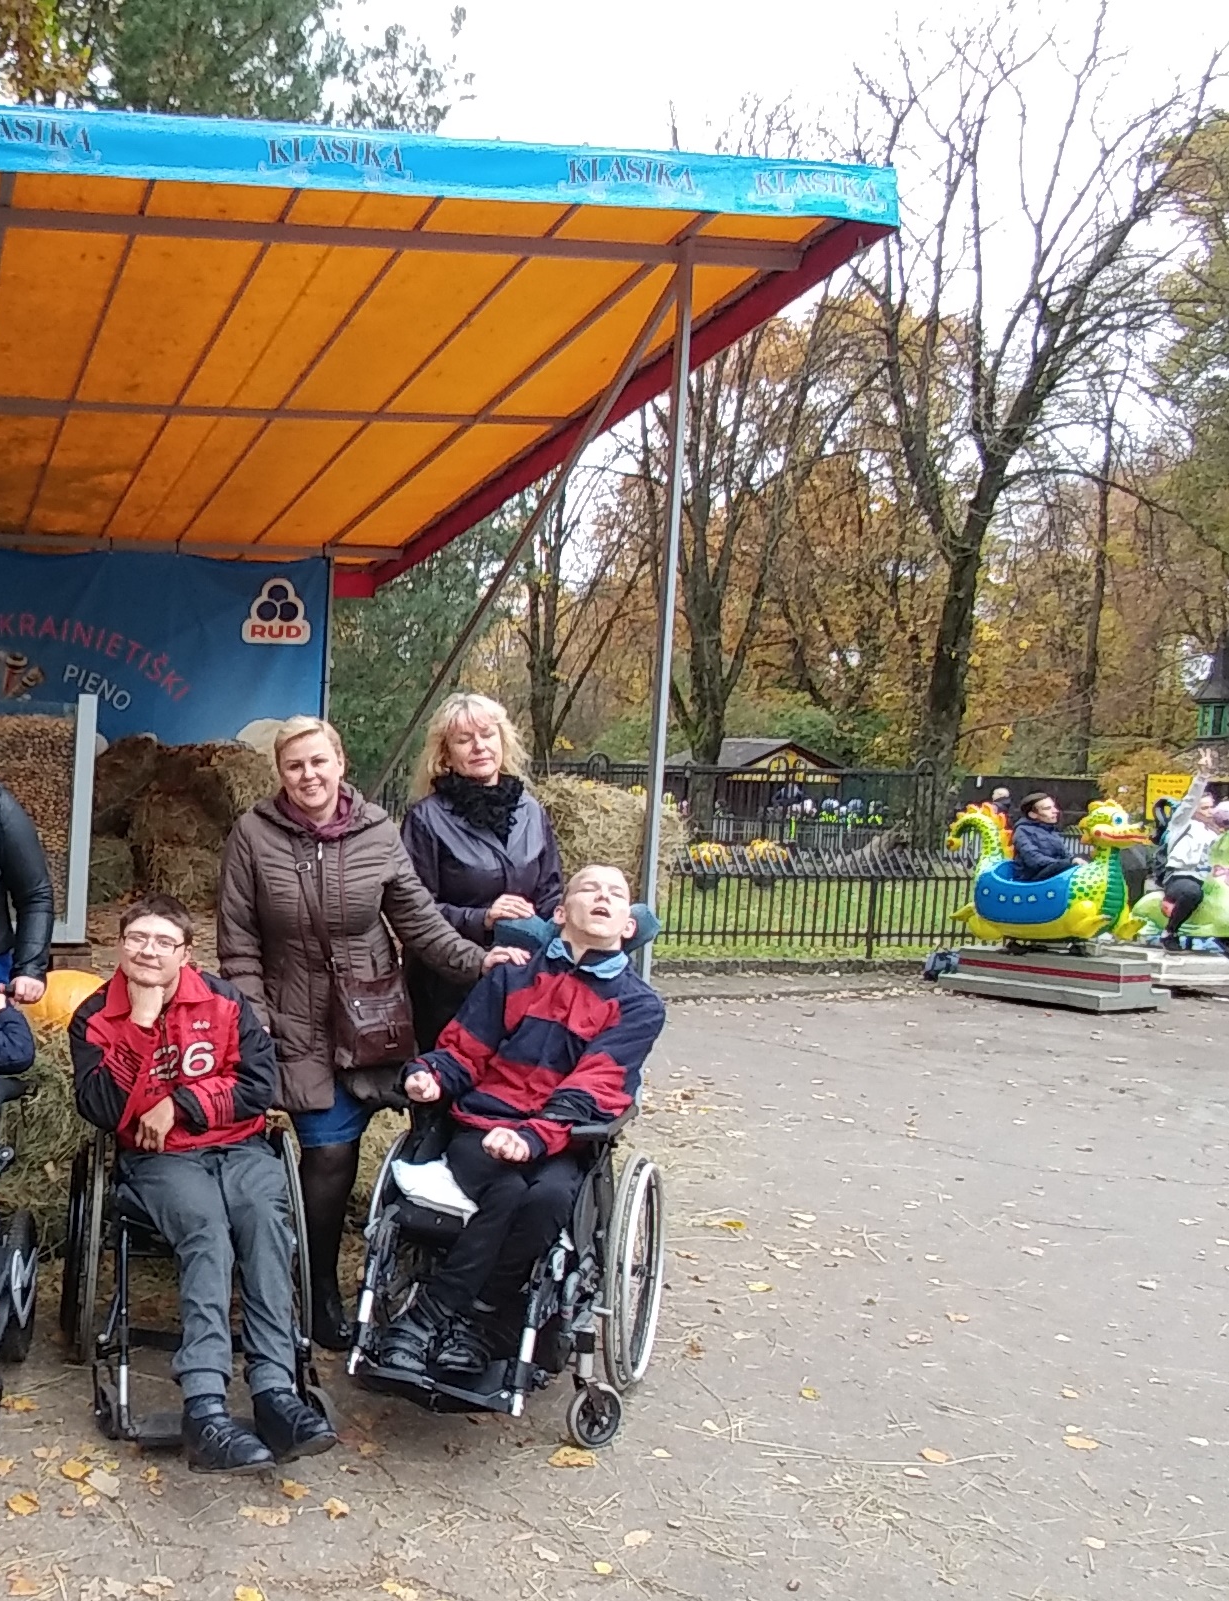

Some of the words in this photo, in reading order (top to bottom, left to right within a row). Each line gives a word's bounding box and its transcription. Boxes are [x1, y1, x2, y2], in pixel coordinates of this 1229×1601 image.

[266, 137, 404, 173] KLASIKA
[569, 157, 694, 193] KLASIKA
[756, 171, 880, 202] KLASIKA
[250, 624, 302, 639] RUD
[62, 663, 132, 711] PIENO
[148, 1041, 215, 1081] 26
